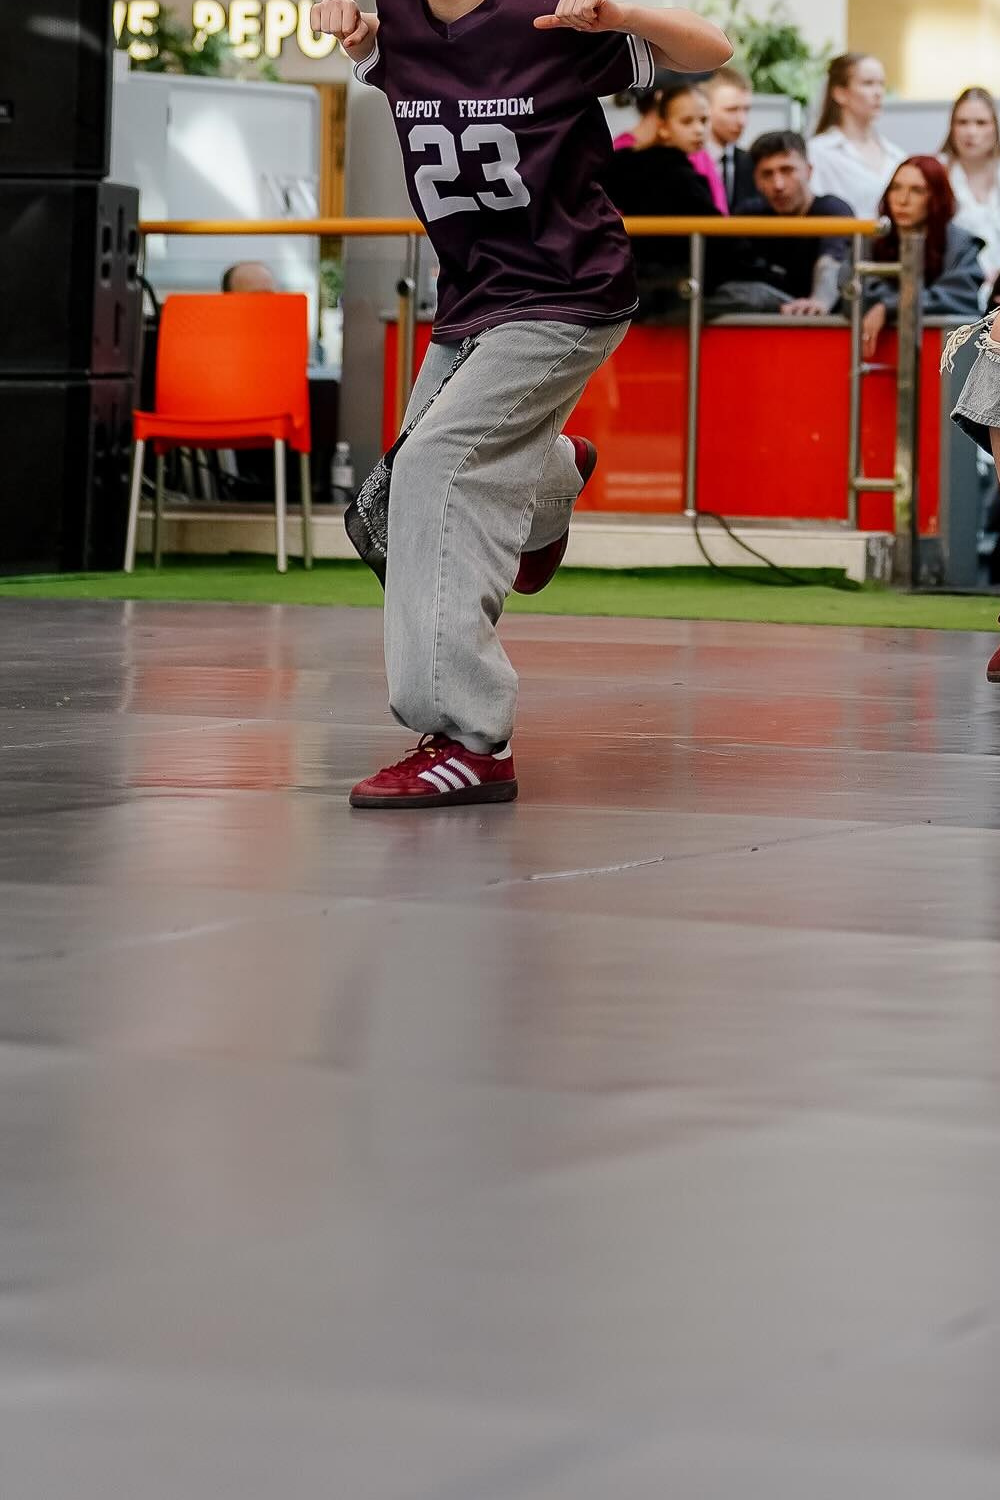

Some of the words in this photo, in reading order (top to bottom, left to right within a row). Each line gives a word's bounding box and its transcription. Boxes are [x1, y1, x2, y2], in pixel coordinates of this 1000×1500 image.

[395, 100, 441, 119] ENJPOY
[457, 97, 535, 118] FREEDOM
[408, 123, 531, 223] 23
